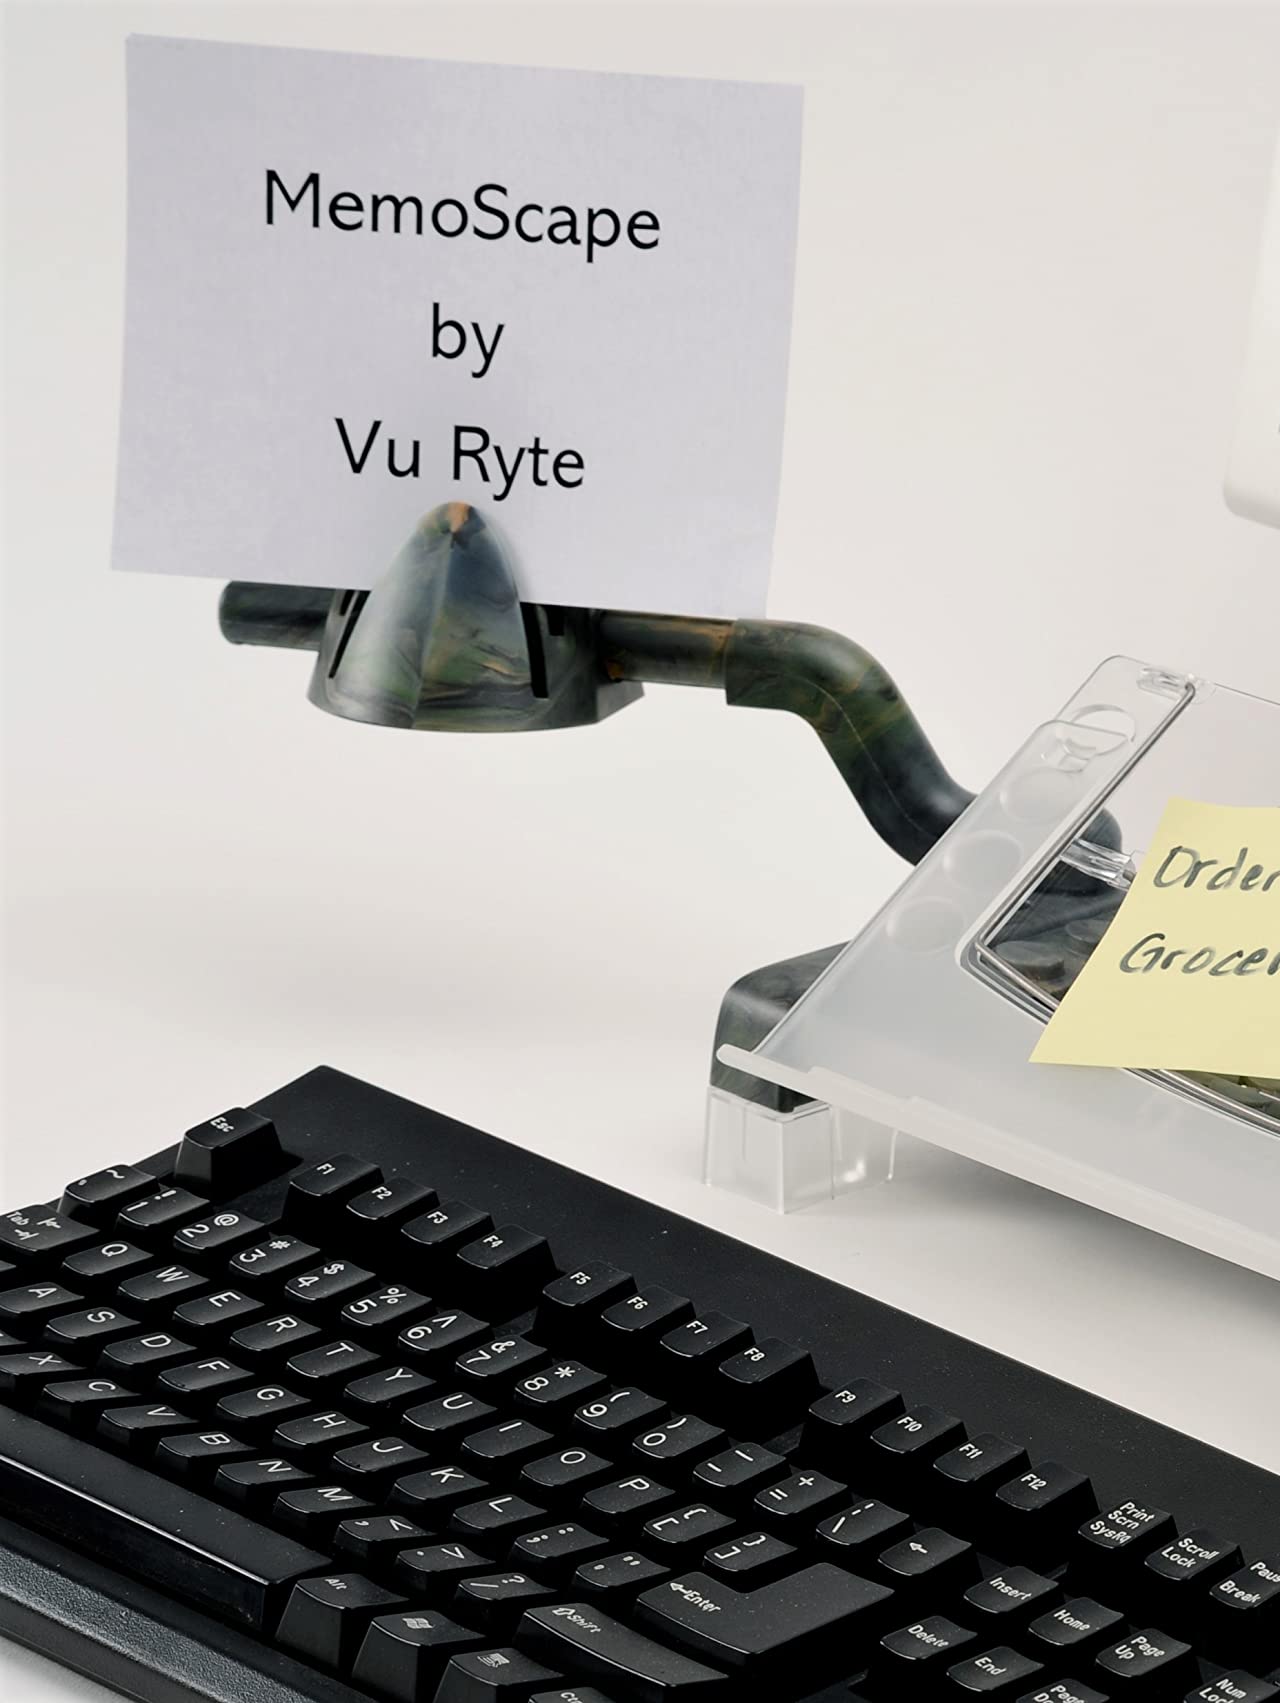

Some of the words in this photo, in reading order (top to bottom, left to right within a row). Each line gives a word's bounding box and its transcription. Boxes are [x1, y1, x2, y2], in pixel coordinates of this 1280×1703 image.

[264, 168, 662, 264] MemoScape
[431, 301, 506, 379] by
[333, 416, 422, 478] Vu
[451, 424, 586, 502] Ryte
[209, 1116, 235, 1134] Esc
[316, 1163, 336, 1175] F1
[371, 1186, 393, 1200] F2
[126, 1201, 149, 1212] 1
[6, 1210, 30, 1227] Tab
[427, 1211, 448, 1224] F3
[181, 1223, 210, 1238] 2
[482, 1234, 504, 1248] F4
[101, 1243, 128, 1257] Q
[239, 1248, 267, 1263] 3
[155, 1266, 190, 1283] W
[297, 1276, 320, 1288] 4
[569, 1271, 592, 1285] F5
[28, 1287, 57, 1299] A
[208, 1291, 242, 1308] E
[349, 1298, 378, 1314] 5
[626, 1296, 648, 1310] F6
[86, 1311, 116, 1323] S
[266, 1316, 298, 1333] R
[407, 1326, 433, 1340] 6
[686, 1320, 709, 1334] F7
[140, 1334, 172, 1348] D
[326, 1342, 354, 1356] T
[466, 1349, 492, 1364] 7
[743, 1347, 765, 1362] F8
[28, 1354, 62, 1366] X
[197, 1360, 231, 1371] F
[385, 1368, 413, 1381] Y
[88, 1381, 116, 1392] C
[523, 1376, 550, 1391] 8
[256, 1388, 285, 1401] G
[442, 1394, 473, 1410] U
[834, 1390, 857, 1403] F9
[146, 1406, 177, 1416] V
[582, 1403, 608, 1418] 9
[312, 1413, 347, 1429] H
[897, 1416, 923, 1432] F10
[199, 1433, 231, 1445] B
[372, 1441, 404, 1453] J
[958, 1443, 983, 1459] F11
[258, 1460, 292, 1473] N
[430, 1467, 465, 1484] K
[1020, 1473, 1047, 1491] F12
[618, 1477, 650, 1490] P
[317, 1487, 353, 1502] M
[488, 1496, 513, 1513] L
[1105, 1507, 1143, 1531] Scrn
[1117, 1501, 1155, 1526] Print
[1090, 1518, 1135, 1544] SysRq
[1161, 1545, 1200, 1568] Lock
[1175, 1537, 1220, 1563] Scroll
[325, 1578, 347, 1590] Alt
[989, 1576, 1032, 1601] Insert
[1219, 1580, 1261, 1603] Break
[685, 1589, 722, 1612] Enter
[566, 1608, 601, 1633] Shift
[1053, 1609, 1091, 1631] Home
[907, 1624, 949, 1648] Delete
[1114, 1644, 1135, 1660] Up
[1129, 1635, 1166, 1659] Page
[974, 1656, 1007, 1676] End
[1214, 1678, 1247, 1701] Num
